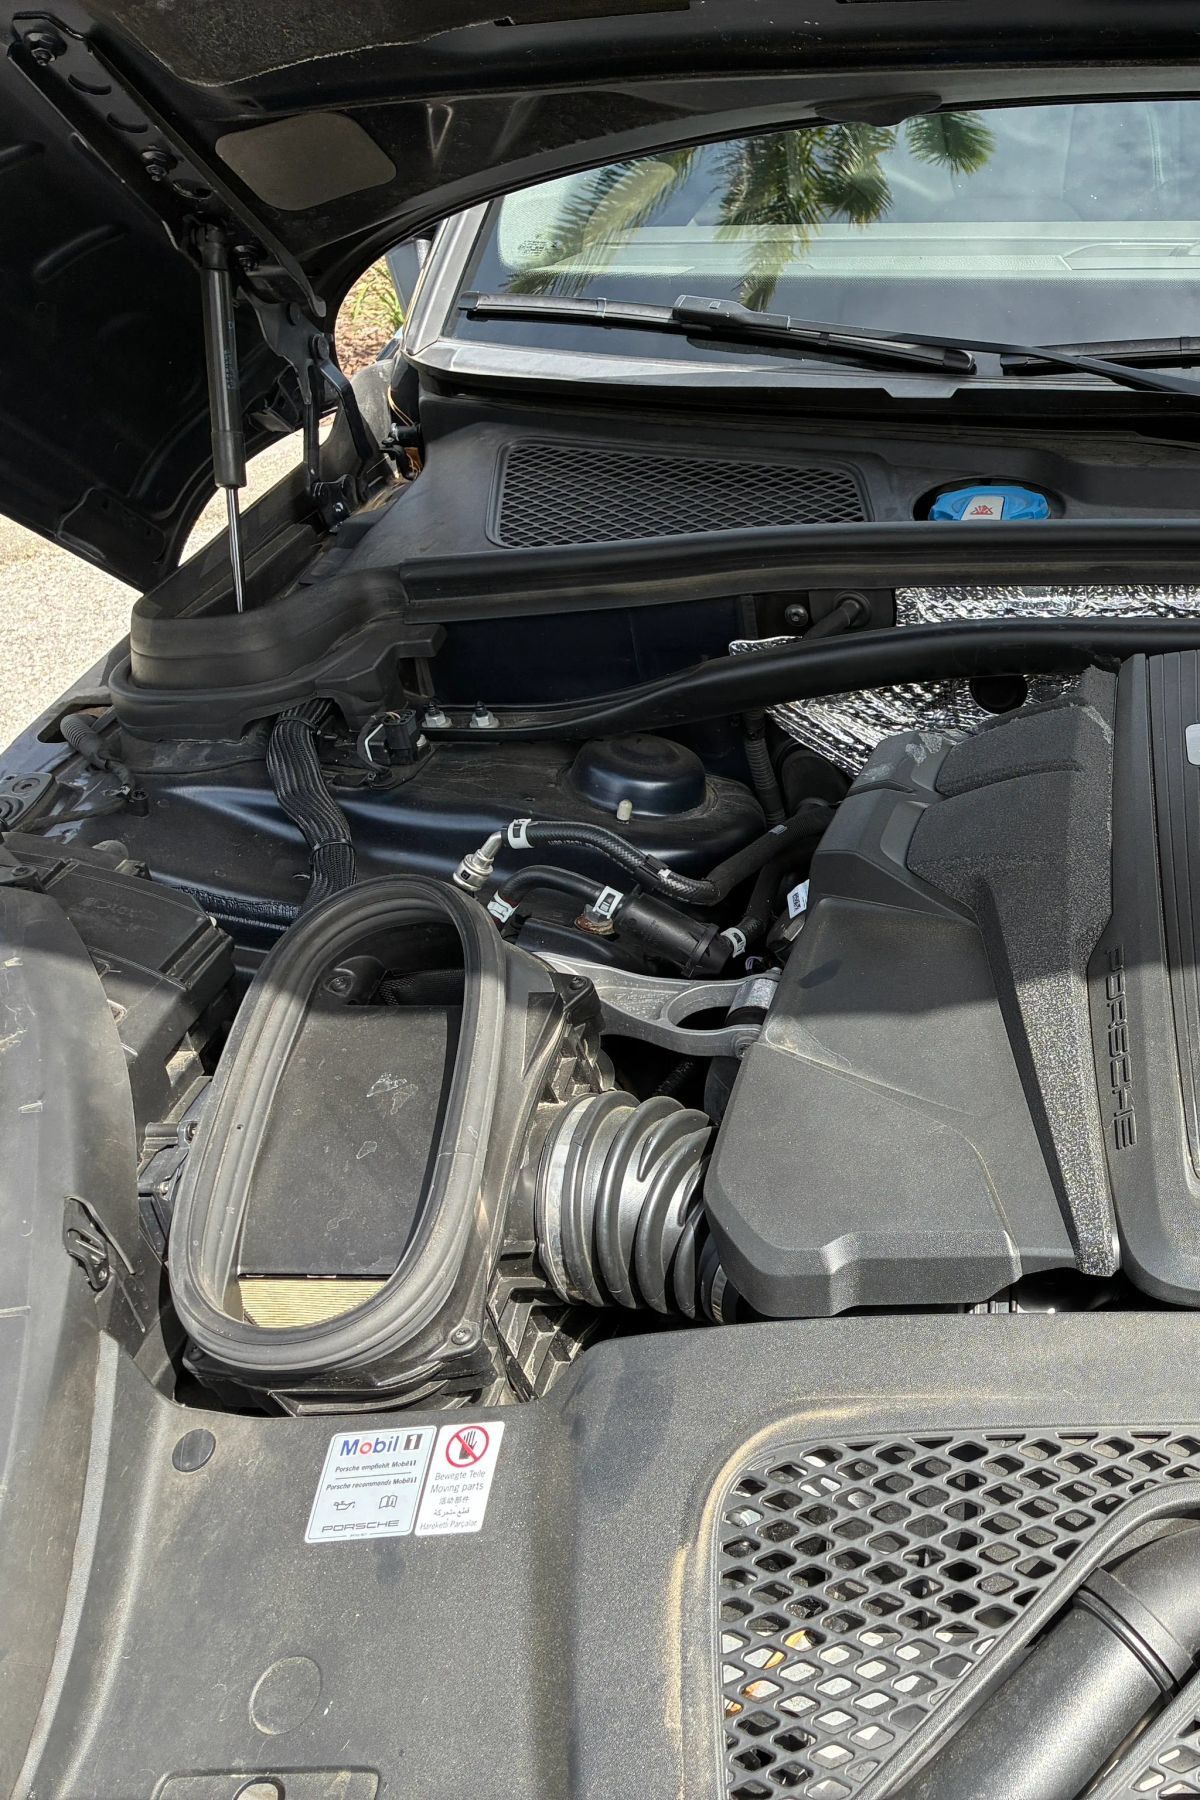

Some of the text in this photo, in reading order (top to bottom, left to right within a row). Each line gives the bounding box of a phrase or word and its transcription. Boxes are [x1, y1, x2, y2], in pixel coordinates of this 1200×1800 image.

[1105, 943, 1138, 1150] PORSCHE
[339, 1435, 400, 1457] Mobil
[335, 1465, 360, 1473] Porsche
[361, 1462, 390, 1471] empfiehlt
[434, 1469, 486, 1480] Bewegte Teile
[326, 1482, 351, 1491] Porsche
[352, 1480, 391, 1489] recommends
[430, 1482, 484, 1493] Moving parts
[321, 1519, 400, 1532] PORSCHE
